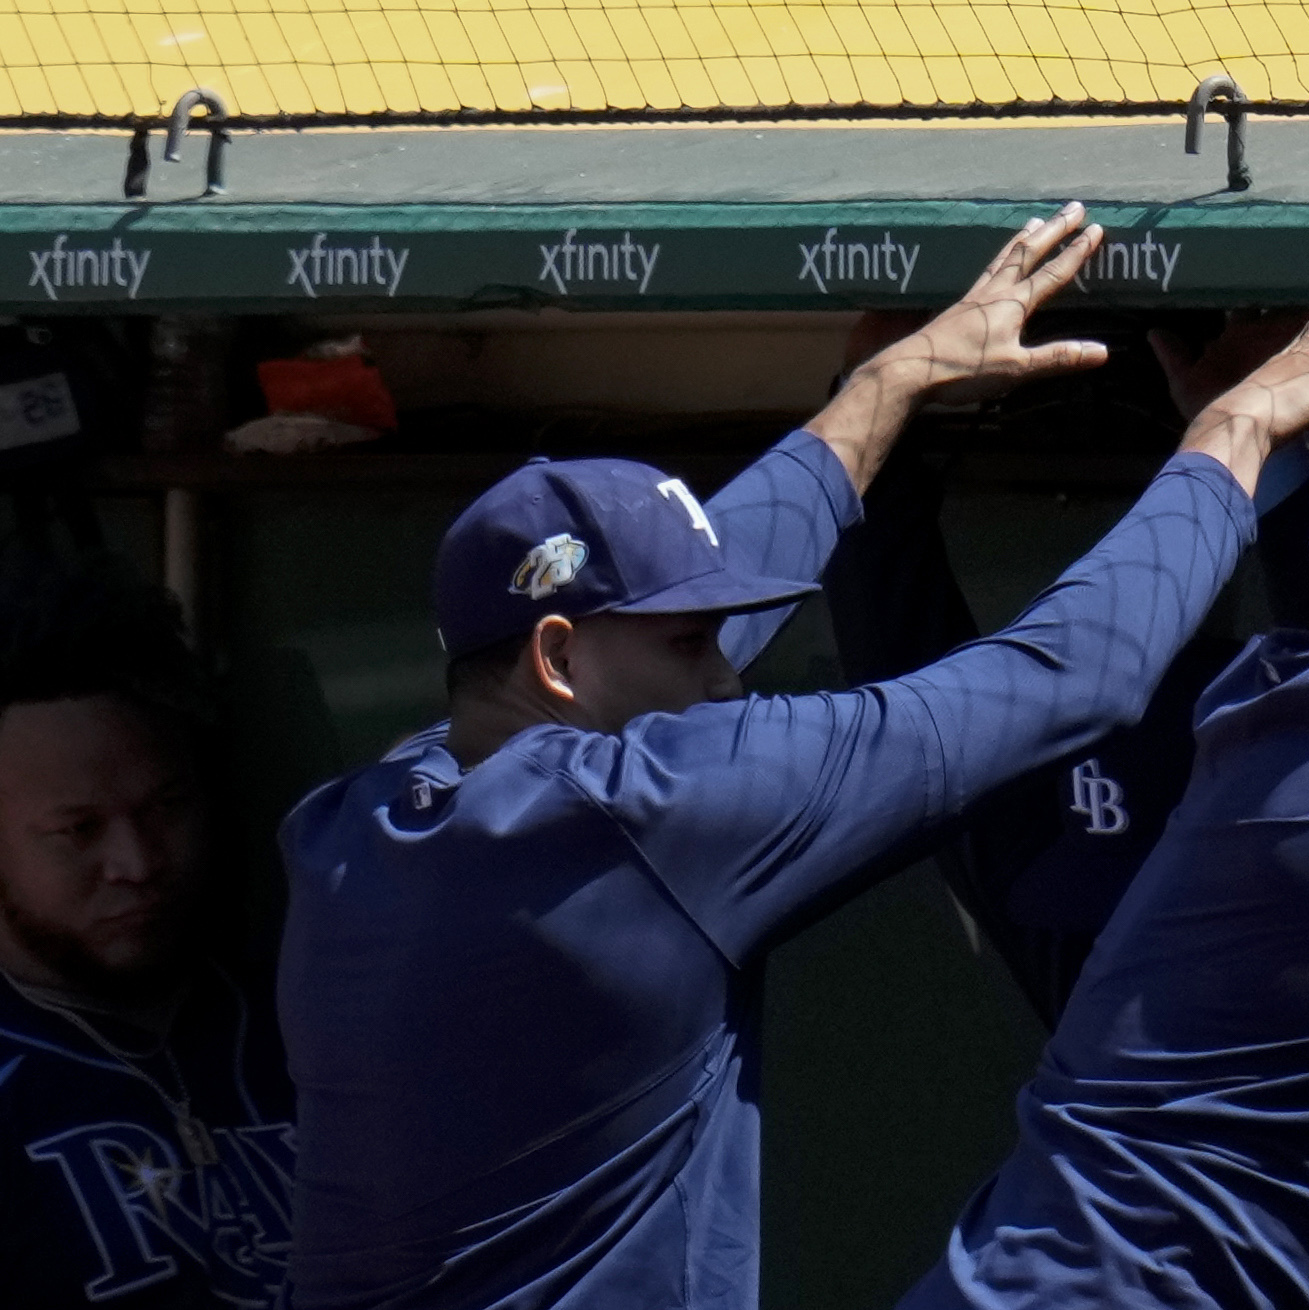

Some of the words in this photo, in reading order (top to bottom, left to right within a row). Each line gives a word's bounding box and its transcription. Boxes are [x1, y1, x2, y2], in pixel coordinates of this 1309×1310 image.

[29, 234, 152, 300] xfinity
[287, 232, 410, 298] xfinity
[539, 228, 660, 295] xfinity
[799, 227, 921, 294] xfinity
[1069, 757, 1131, 836] TB
